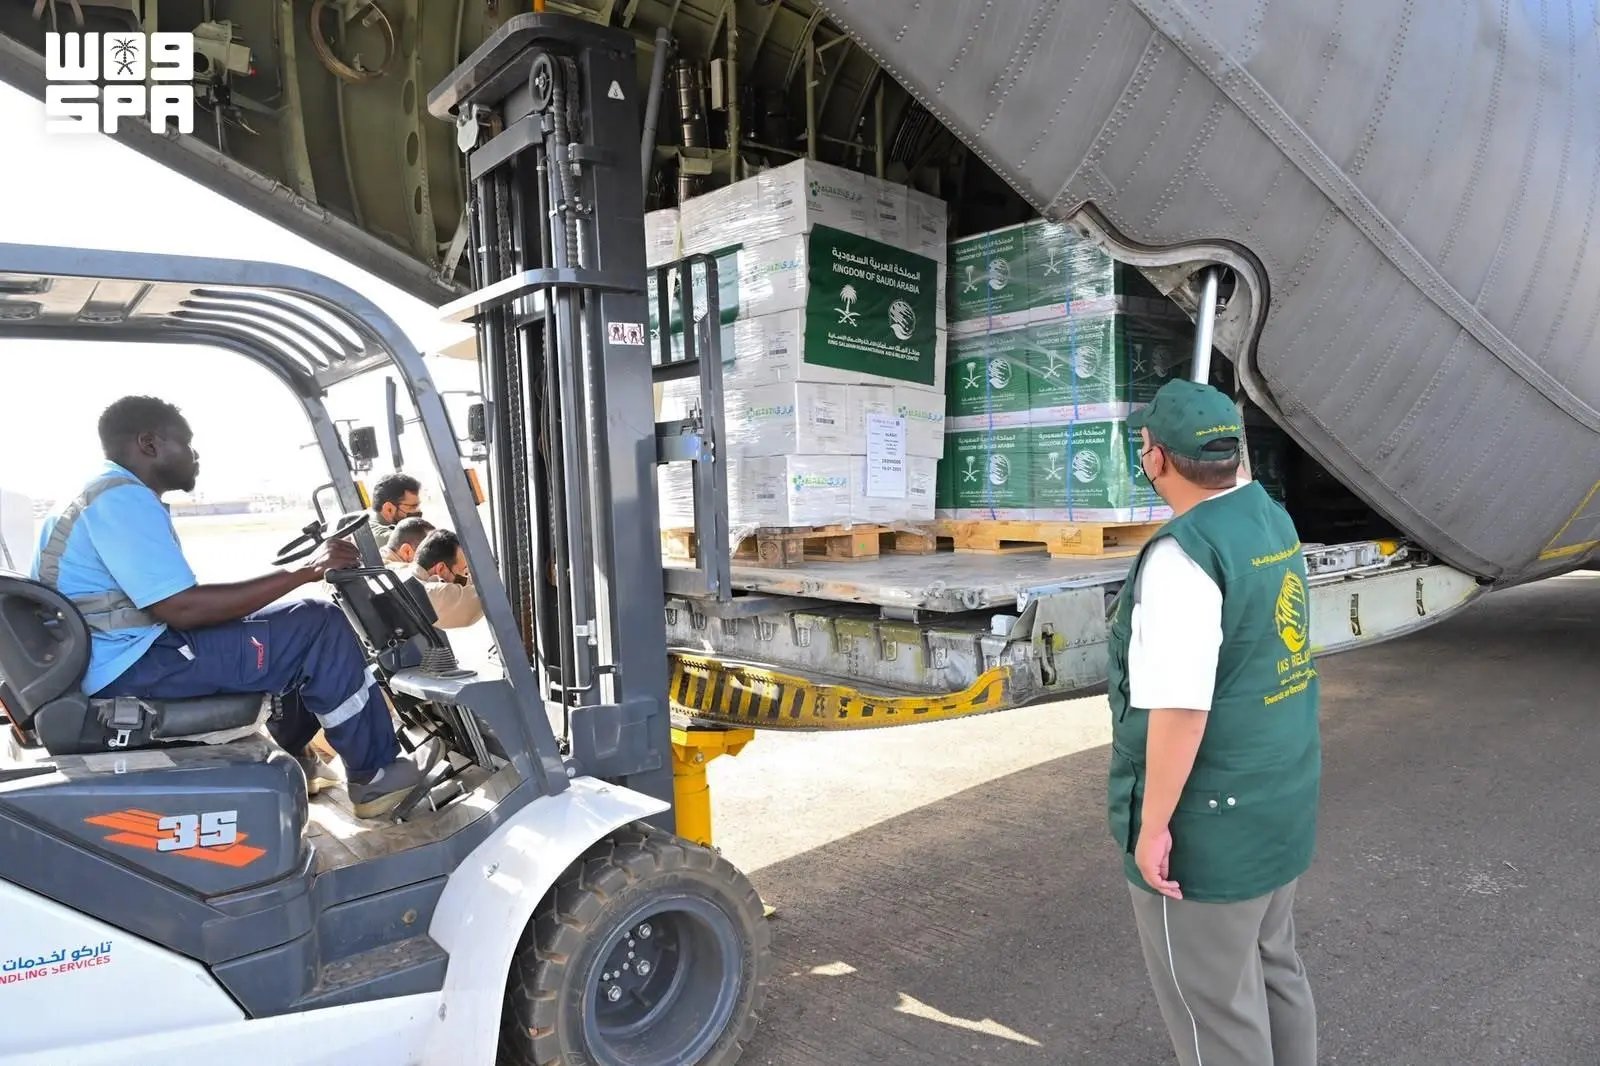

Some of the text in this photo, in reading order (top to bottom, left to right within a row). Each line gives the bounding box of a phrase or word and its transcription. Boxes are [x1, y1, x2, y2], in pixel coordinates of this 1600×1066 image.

[832, 246, 920, 281] المملكة العربية السعودية
[832, 262, 920, 294] KINGDOM OF SAUDI ARABIA
[157, 810, 238, 851] 35
[0, 955, 111, 985] NDLING SERVICES
[3, 941, 112, 971] تاركو لخدمات
